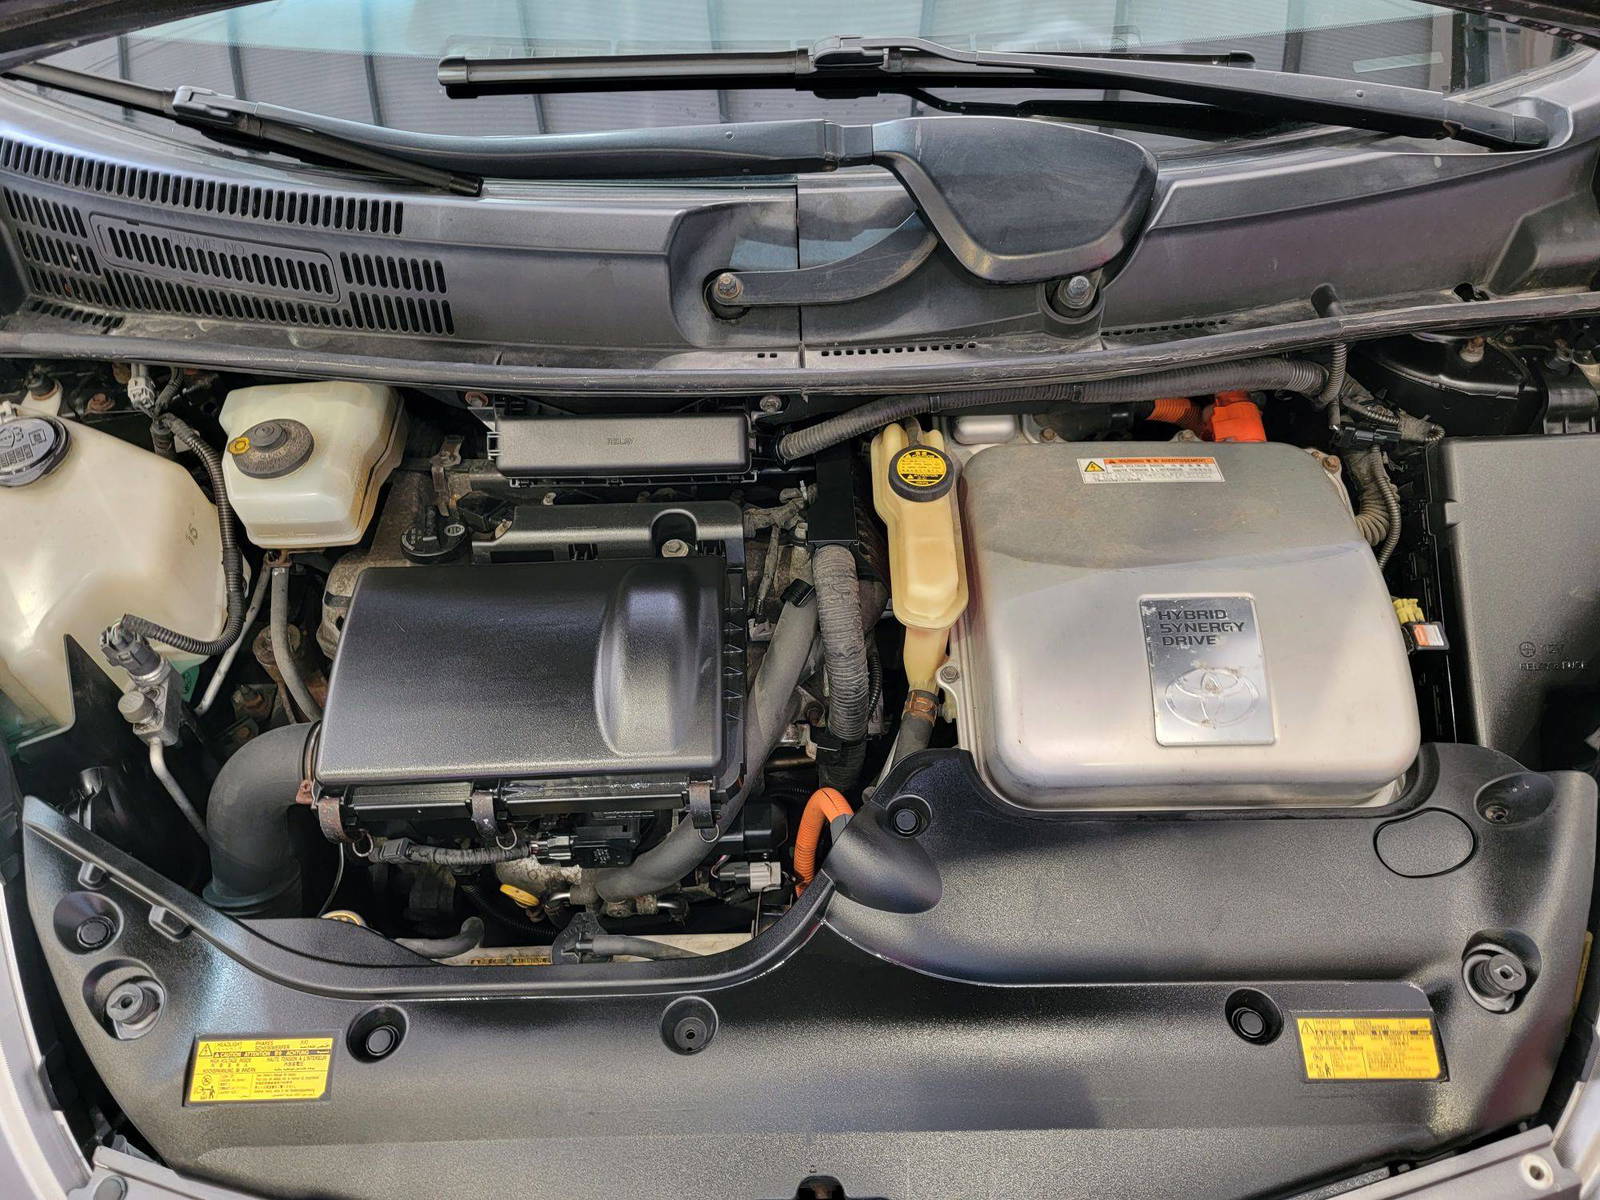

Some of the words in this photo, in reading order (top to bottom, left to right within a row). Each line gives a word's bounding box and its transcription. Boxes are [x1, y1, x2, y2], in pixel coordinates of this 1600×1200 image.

[1158, 609, 1227, 621] HYBRID
[1160, 621, 1246, 634] SYNERGY
[1161, 634, 1217, 646] DRIVE
